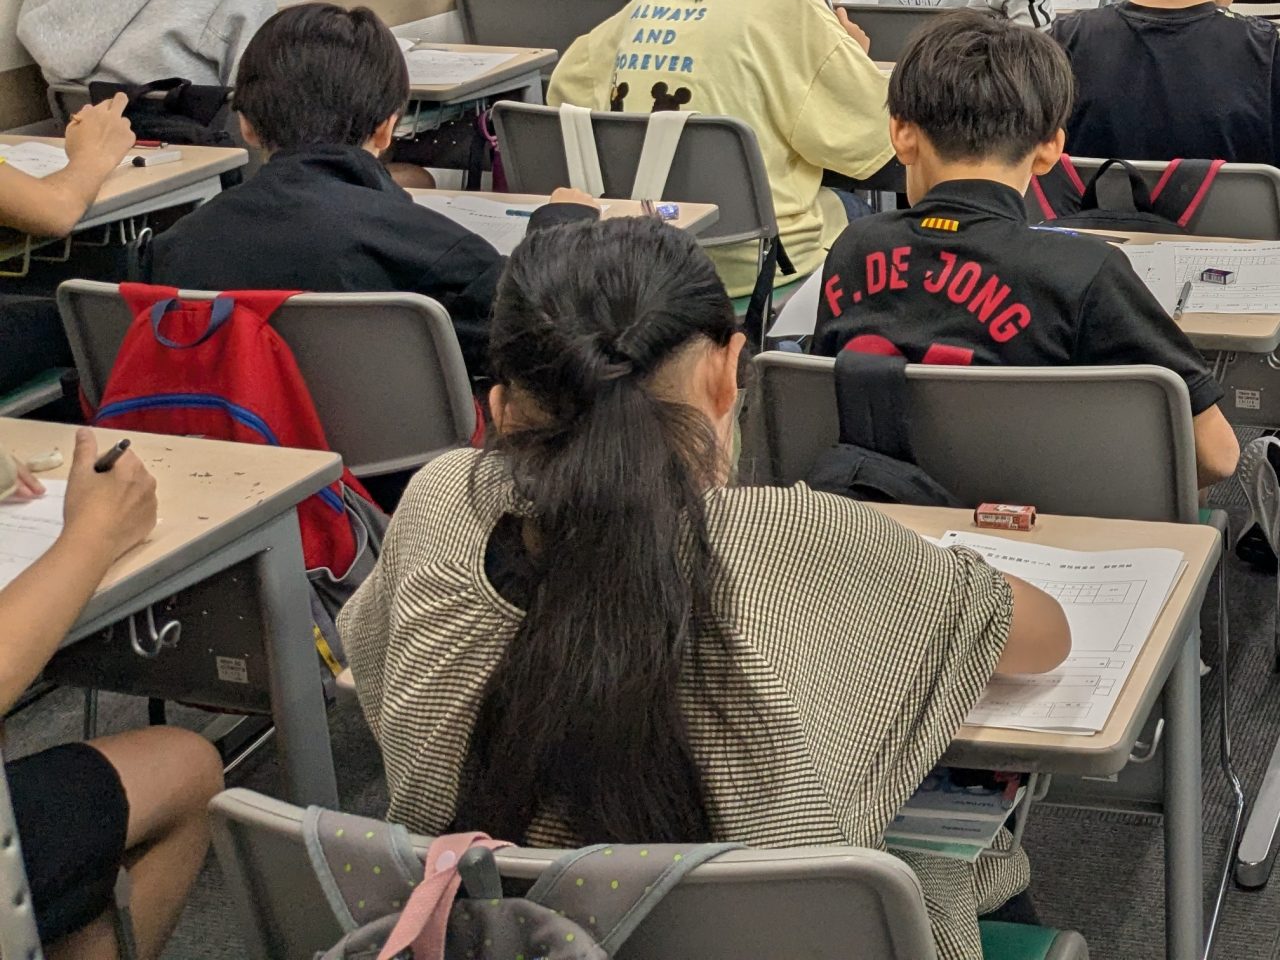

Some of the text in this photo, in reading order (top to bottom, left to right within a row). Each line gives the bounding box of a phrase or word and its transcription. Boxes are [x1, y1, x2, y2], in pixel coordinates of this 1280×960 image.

[630, 5, 707, 21] ALWAYS
[633, 28, 677, 45] AND
[922, 250, 1031, 343] JONG
